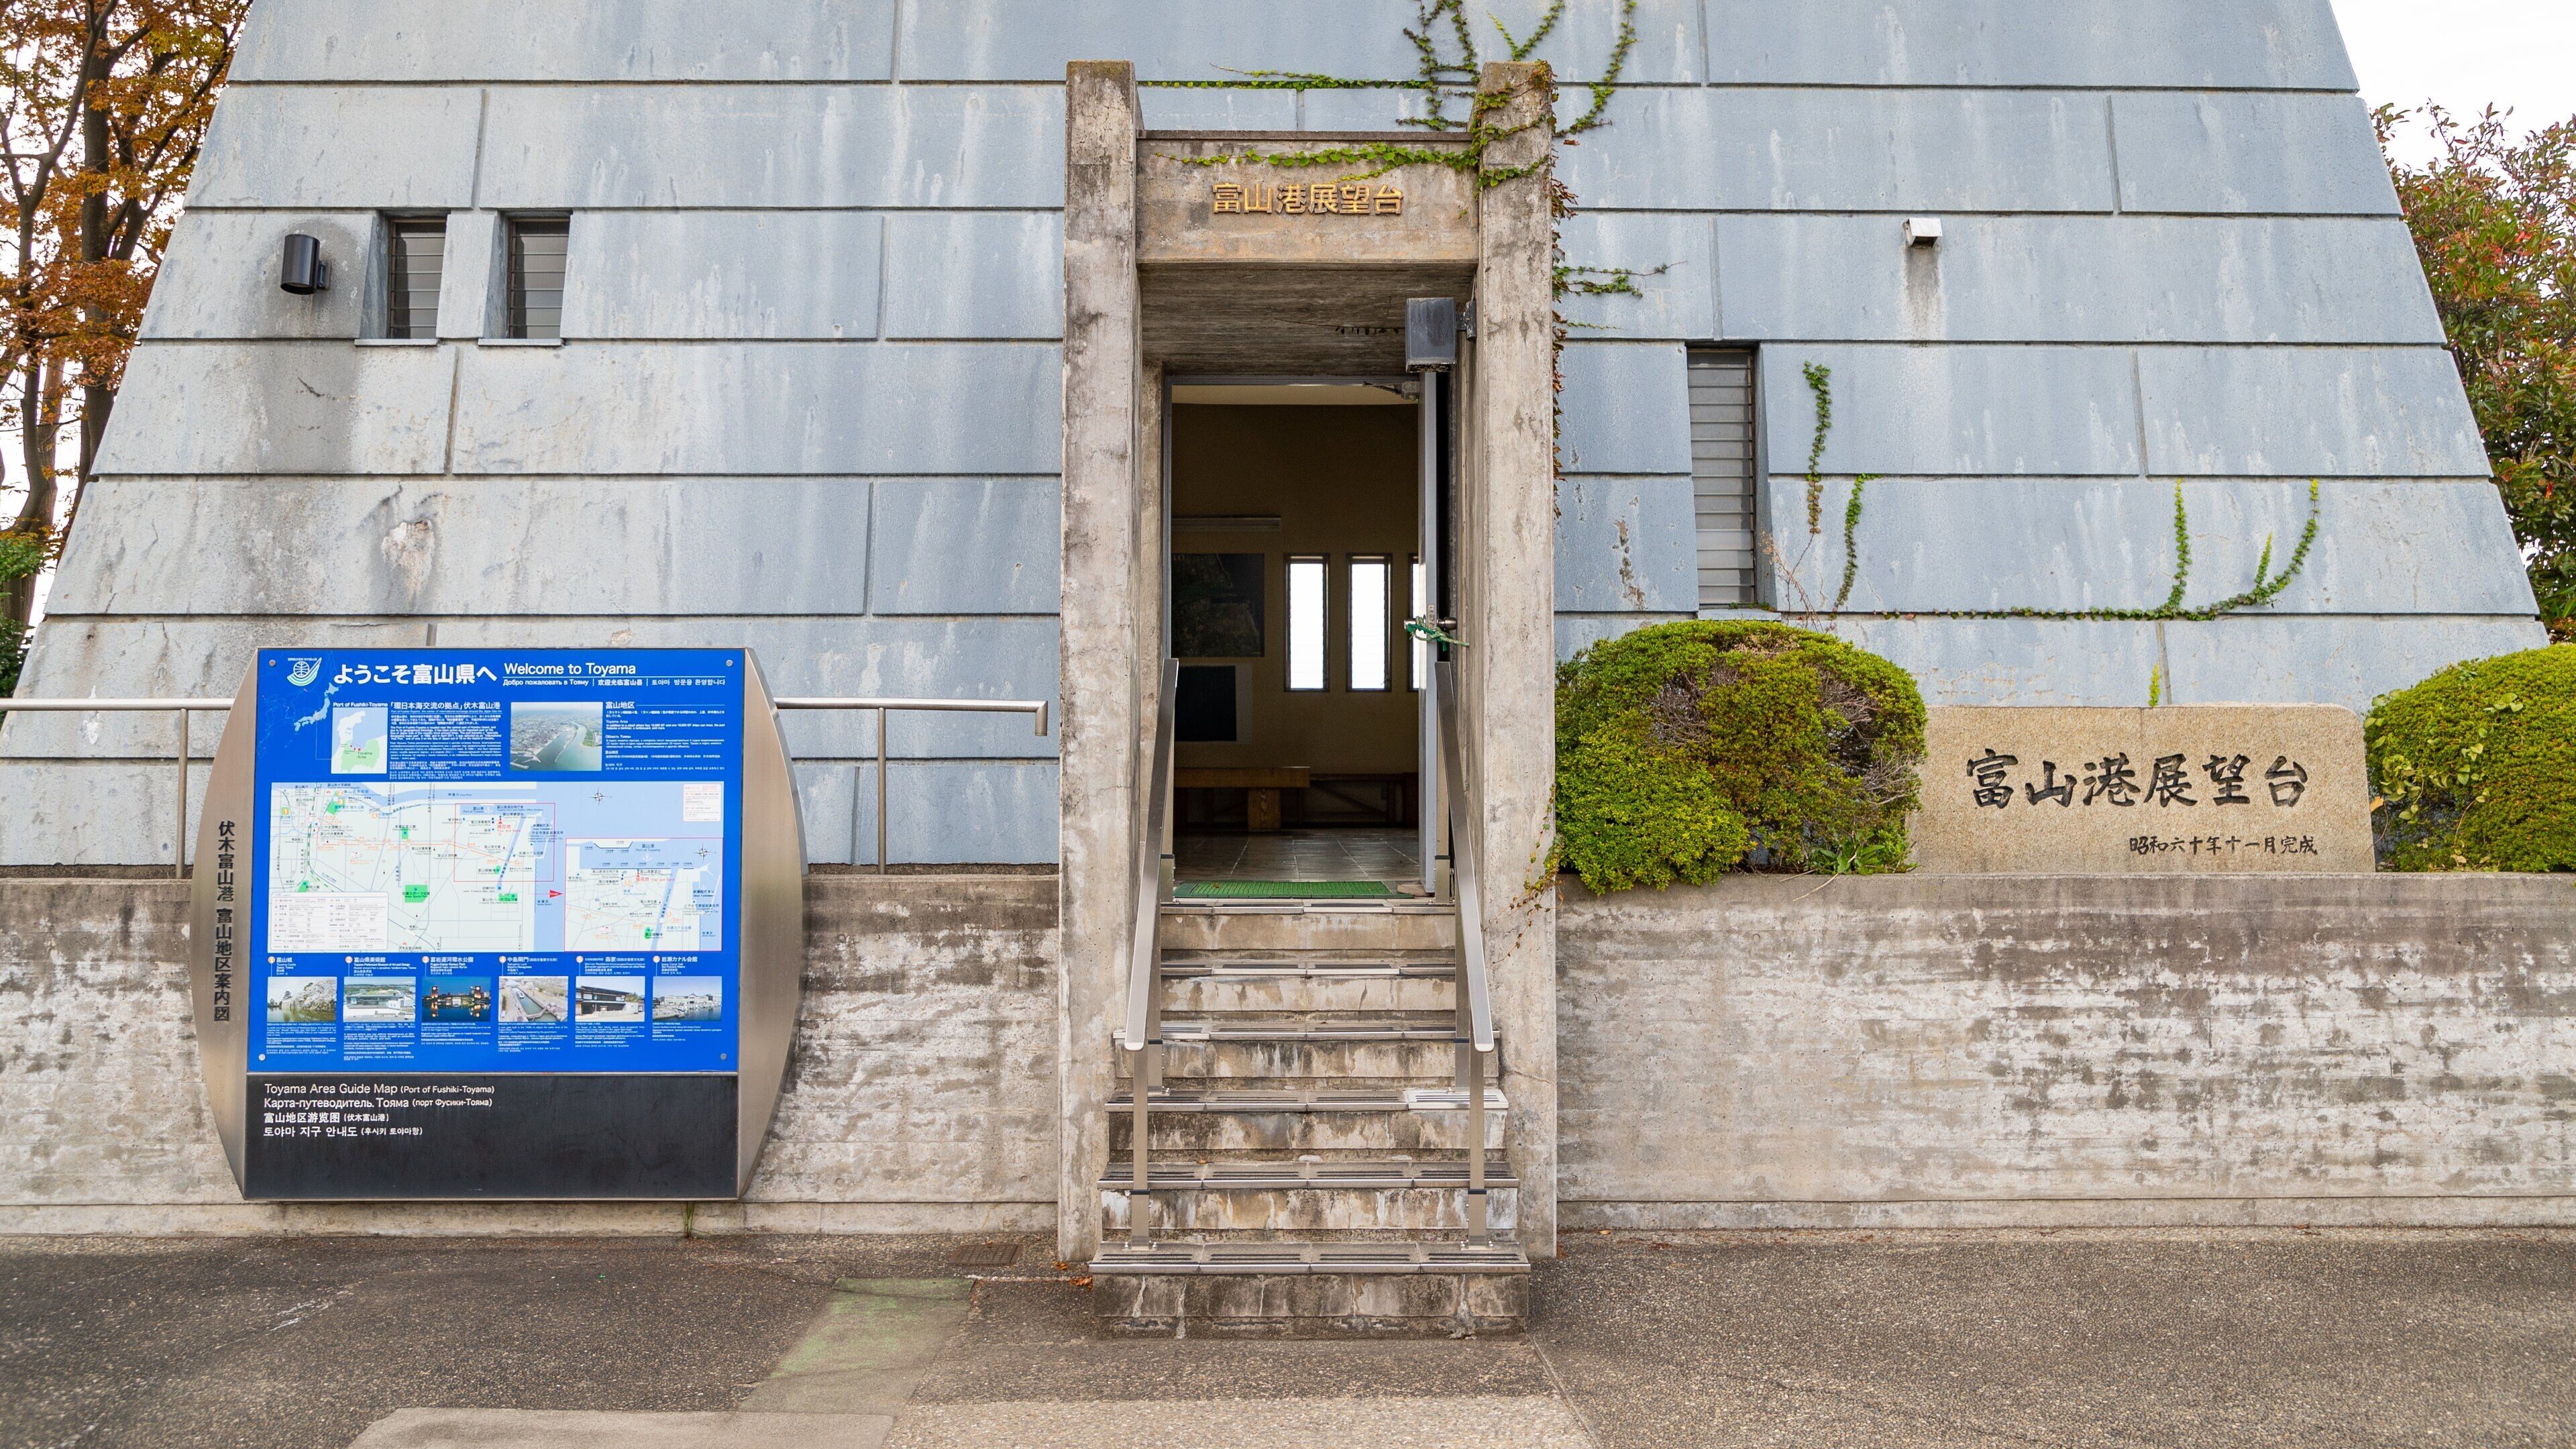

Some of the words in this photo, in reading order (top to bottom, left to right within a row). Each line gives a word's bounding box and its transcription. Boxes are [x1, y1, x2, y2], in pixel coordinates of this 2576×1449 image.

[1212, 183, 1403, 215] 富山港展望台
[334, 663, 497, 685] ようこそ富山県へ
[504, 662, 564, 675] Welcome
[568, 663, 582, 675] to
[586, 662, 636, 676] Toyama
[391, 702, 500, 710] 「環日本海交流の拠点」伏木富山港
[1966, 748, 2308, 809] 富山港展望台
[2129, 835, 2318, 855] 昭和六十年十一月完成
[218, 821, 235, 902] 伏木富山港
[214, 908, 233, 1022] 富山地区案内図
[264, 1084, 307, 1095] Toyama
[310, 1084, 335, 1093] Area
[339, 1084, 370, 1093] Guide
[374, 1084, 397, 1095] Map
[400, 1085, 417, 1094] (Port
[419, 1085, 431, 1093] of
[432, 1085, 494, 1094] Fushiki-Toyama)
[376, 1097, 409, 1107] Тояма
[412, 1098, 433, 1107] (порт
[435, 1097, 492, 1107] Фусики-Тояма)
[264, 1113, 340, 1123] 富山地区游览图
[344, 1114, 388, 1122] (伏木富山港)
[264, 1126, 295, 1137] 토야마
[300, 1126, 321, 1137] 지구
[326, 1126, 358, 1137] 안내도
[361, 1127, 386, 1136] (후시키
[390, 1127, 423, 1136] 토야마항)
